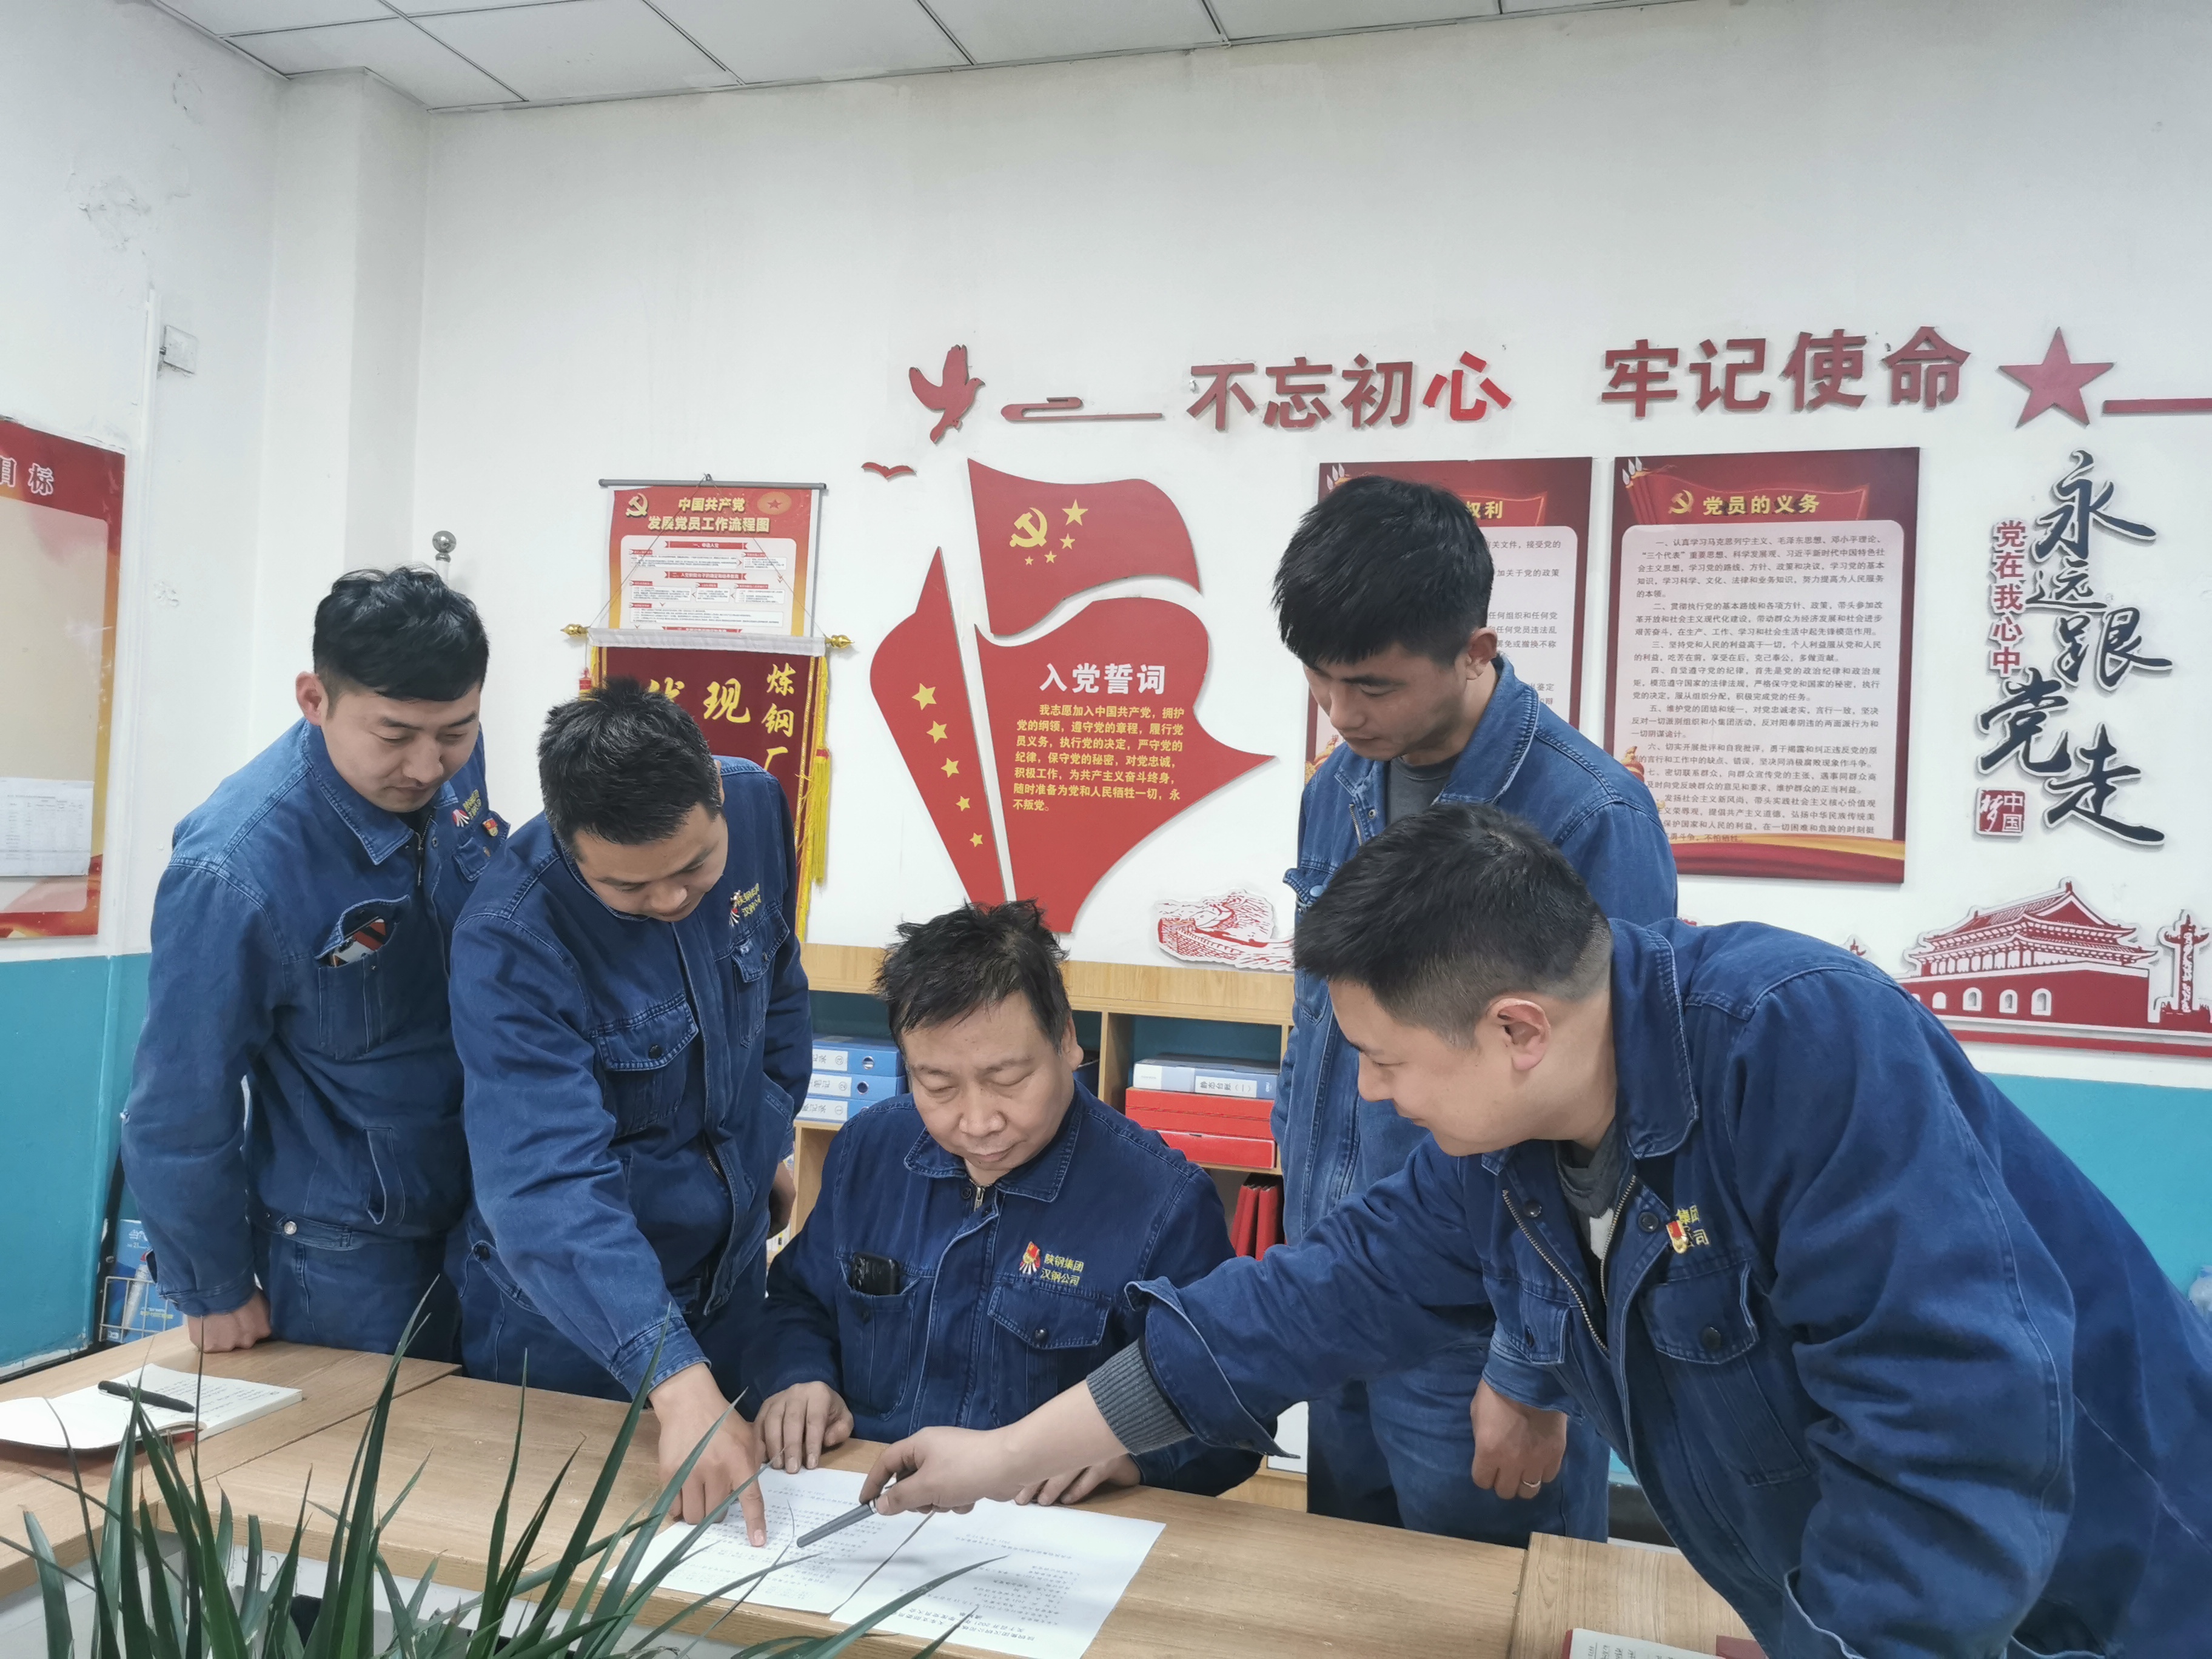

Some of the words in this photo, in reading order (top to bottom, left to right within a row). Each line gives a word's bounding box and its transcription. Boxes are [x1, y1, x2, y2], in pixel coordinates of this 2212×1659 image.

[1186, 350, 1512, 431] 不忘初心
[1601, 326, 1971, 418] 牢记使命
[678, 497, 746, 512] 中国共产党
[1703, 494, 1820, 516] 党员的义务
[648, 515, 770, 533] 发展党员工作流程图
[1991, 519, 2025, 674] 党在我心中
[1489, 611, 1558, 620] 任何组织和任何党
[1039, 663, 1165, 694] 入党誓词
[762, 662, 796, 771] 炼钢厂
[1039, 704, 1184, 720] 我志愿加入中国共产党，拥护
[1016, 719, 1184, 736] 党的纲领，遵守党的章程，履行党
[1016, 735, 1183, 752] 员义务，执行党的决定，严守党的
[1015, 751, 1175, 768] 纪律，保守党的秘密，对党忠诚，
[1014, 766, 1175, 785] 积极工作，为共产主义奋斗终身，
[1013, 783, 1181, 801] 随时准备为党和人民牺牲一切，永
[1013, 799, 1050, 812] 不叛党。
[809, 1079, 830, 1089] 笔记
[1044, 1253, 1085, 1273] 陕钢集团
[1040, 1267, 1081, 1286] 汉钢公司
